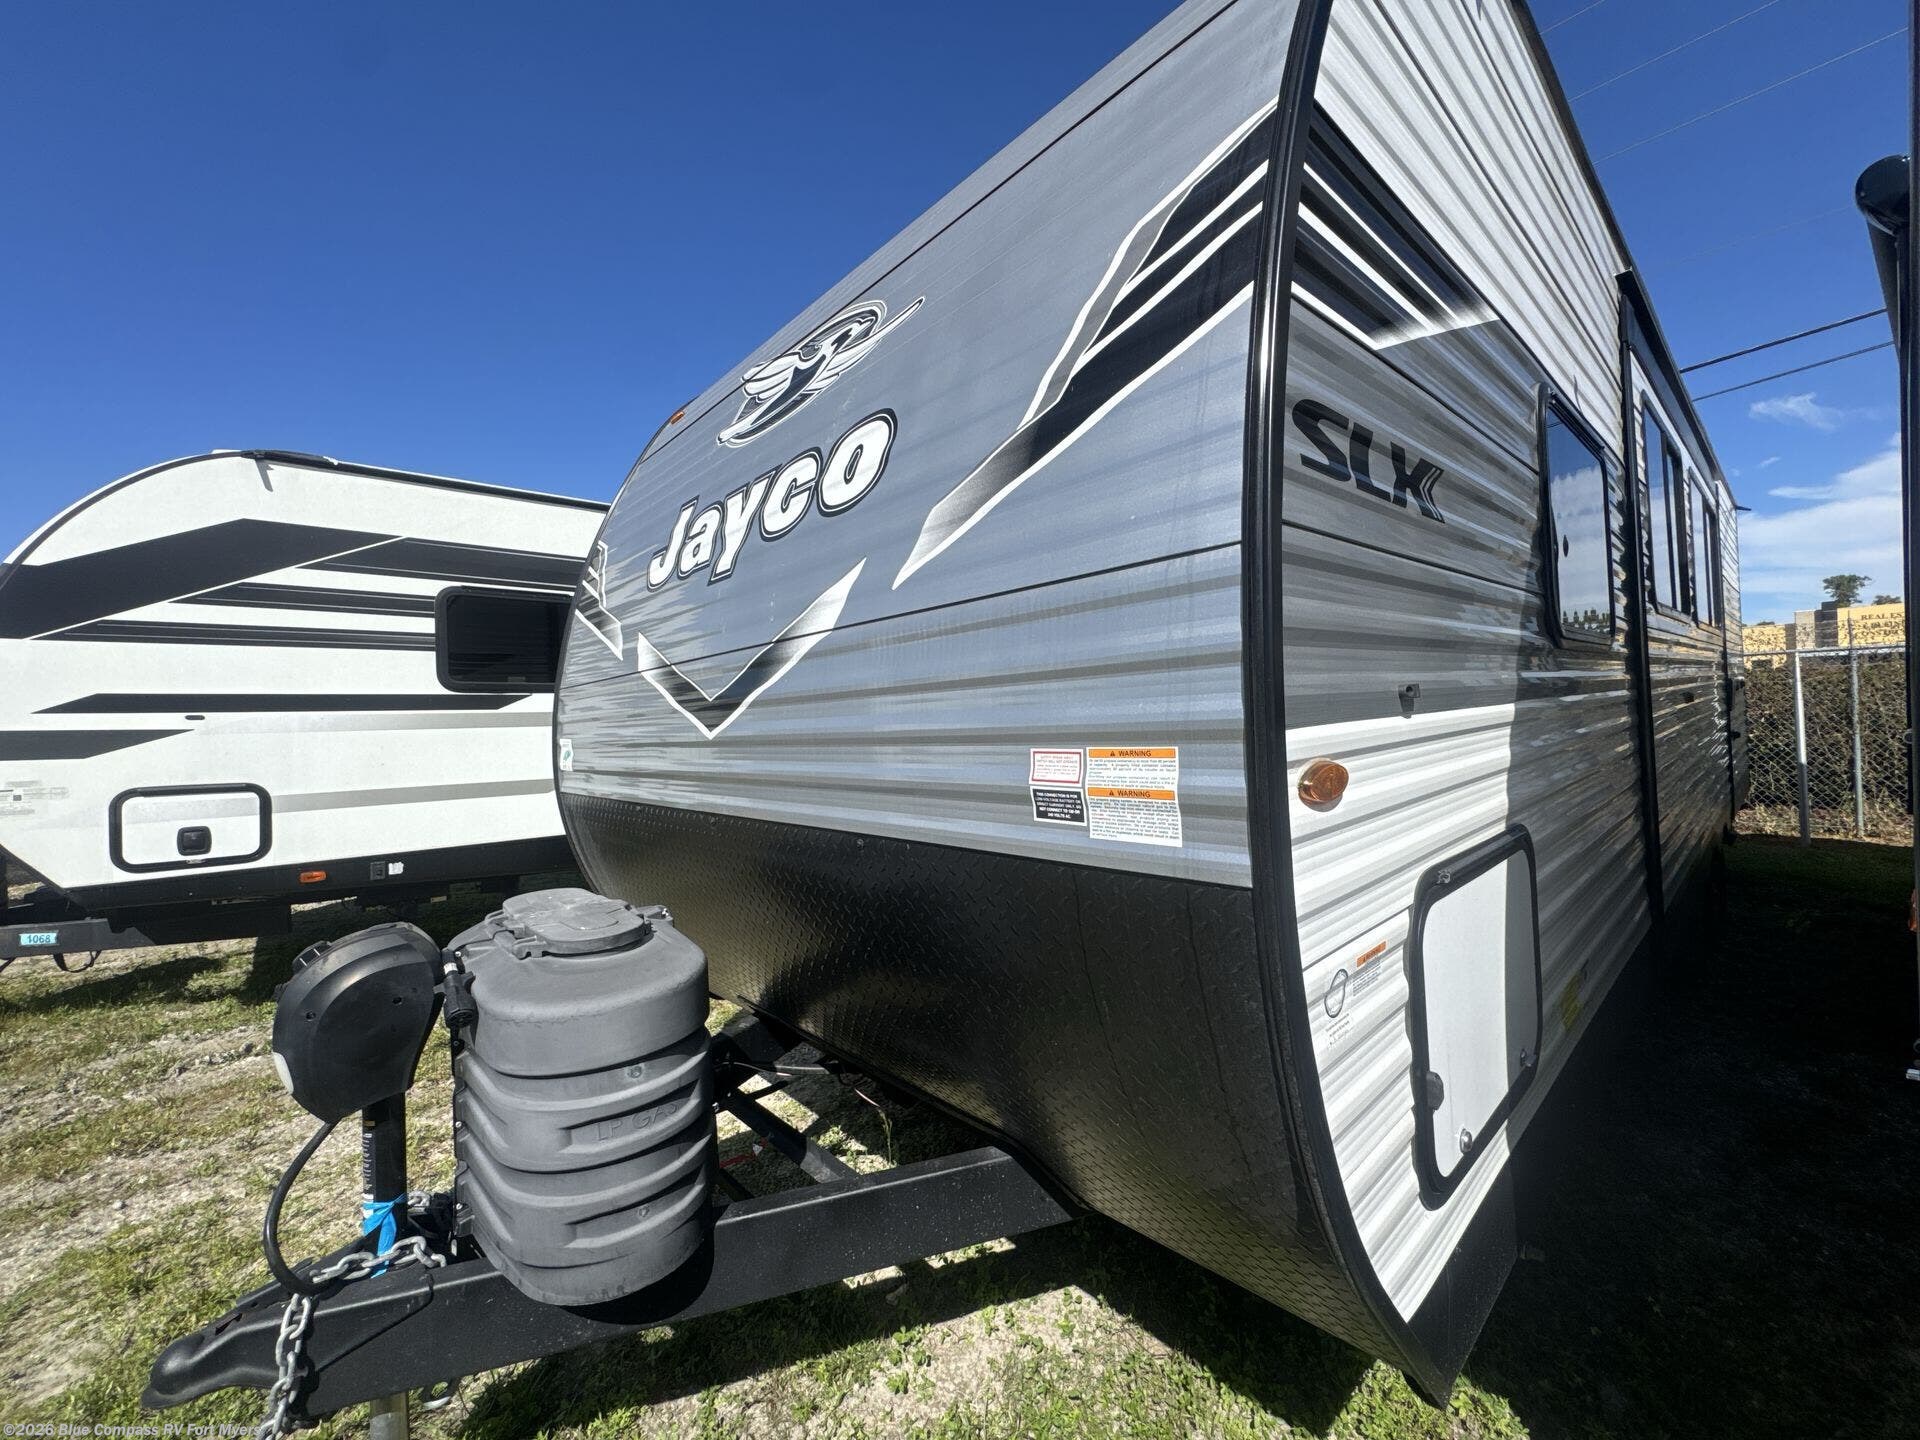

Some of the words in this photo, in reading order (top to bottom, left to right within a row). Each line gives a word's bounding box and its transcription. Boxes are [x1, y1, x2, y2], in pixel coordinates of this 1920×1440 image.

[1117, 790, 1151, 798] WARNING
[27, 934, 51, 943] 1068
[594, 1120, 623, 1141] LP
